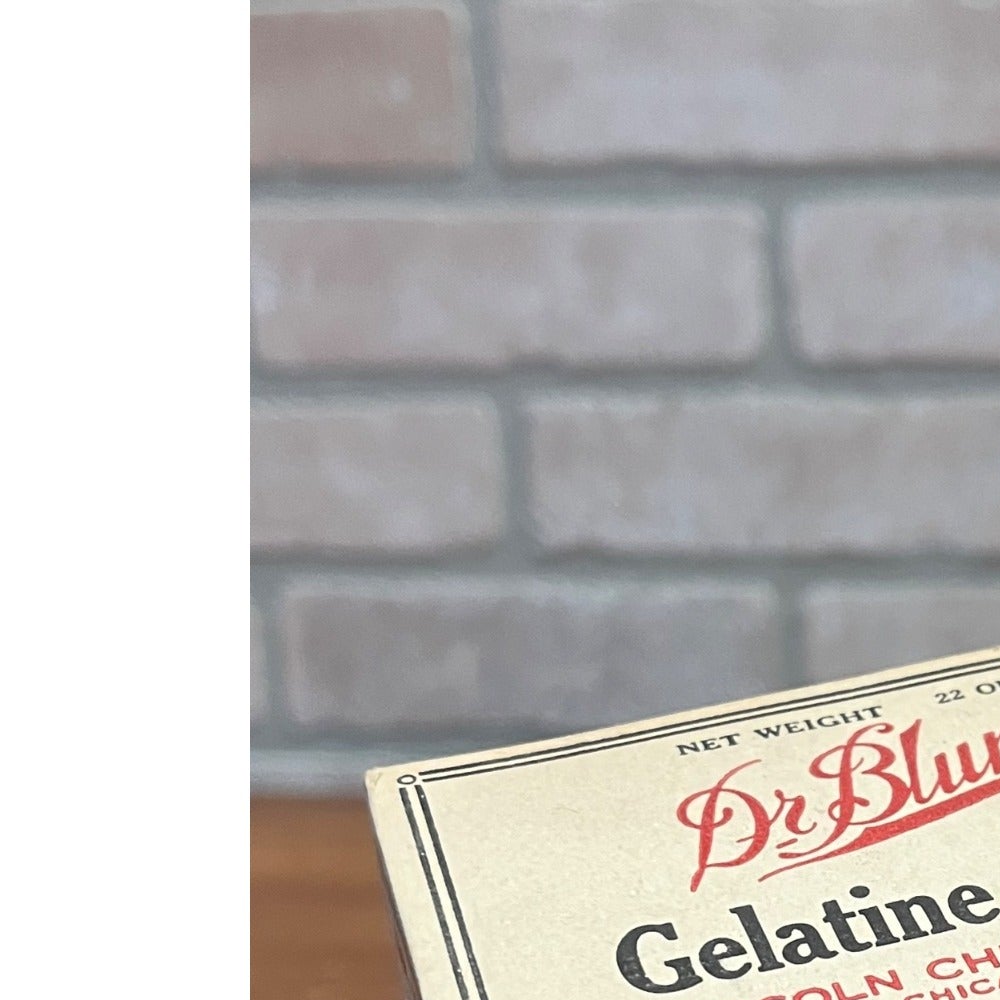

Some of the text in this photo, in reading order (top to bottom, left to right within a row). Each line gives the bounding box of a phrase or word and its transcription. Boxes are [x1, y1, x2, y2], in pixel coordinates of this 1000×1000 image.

[677, 731, 740, 757] NET
[755, 704, 884, 741] WEIGHT
[935, 689, 965, 704] 22
[676, 759, 818, 892] Dr
[614, 884, 1000, 995] Gelatine
